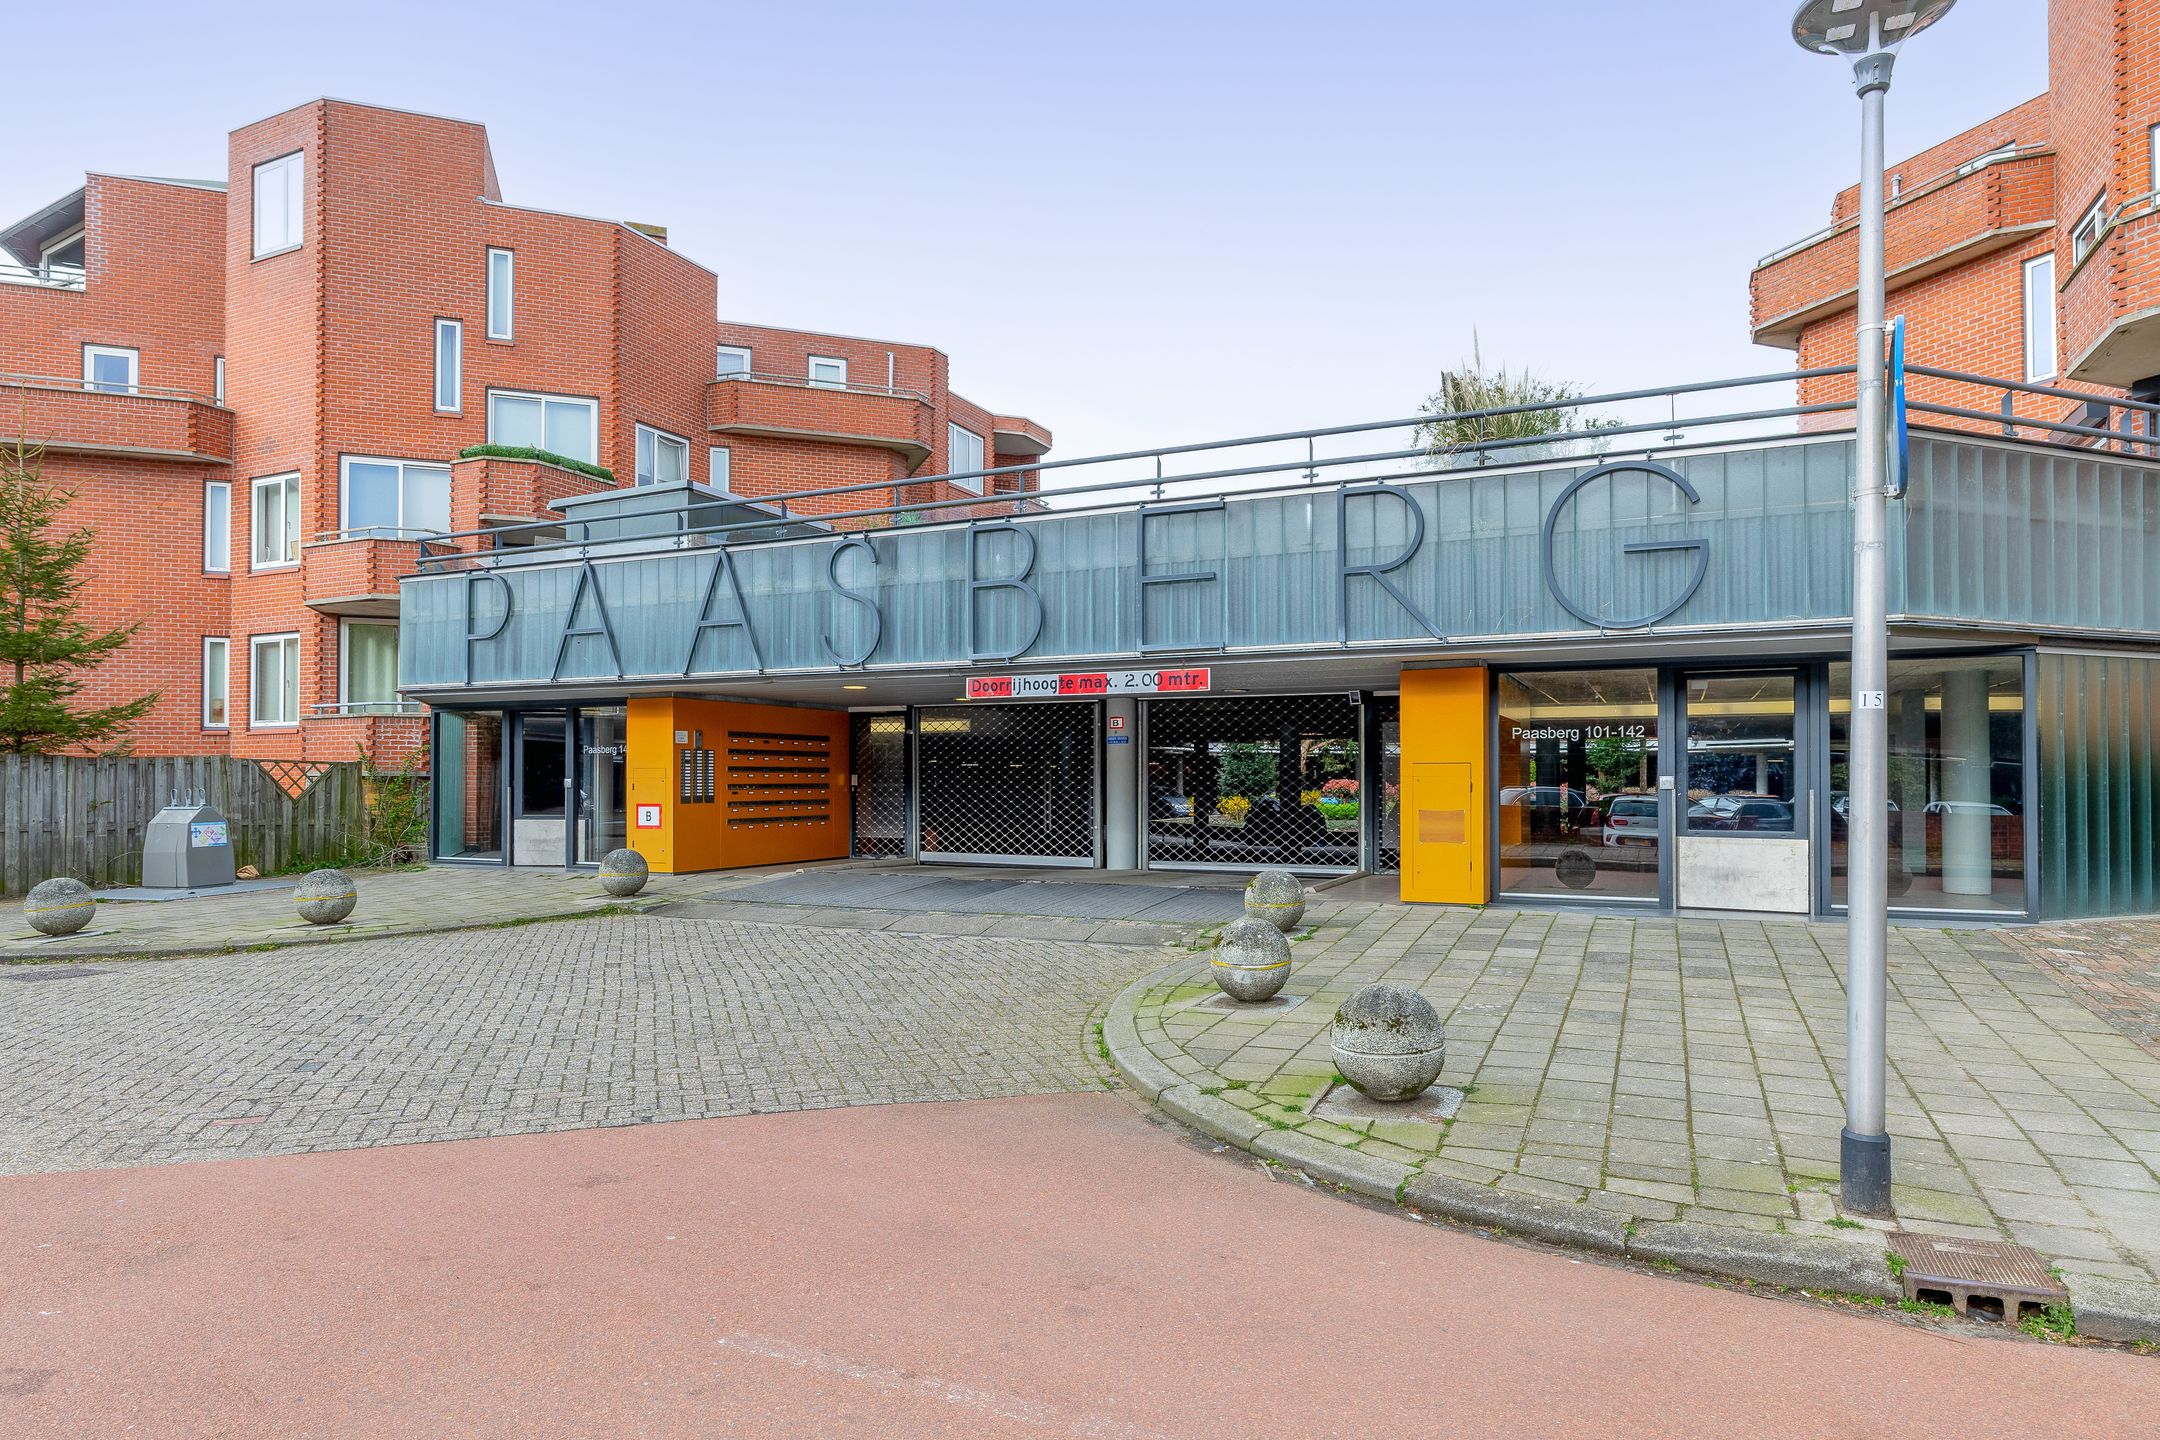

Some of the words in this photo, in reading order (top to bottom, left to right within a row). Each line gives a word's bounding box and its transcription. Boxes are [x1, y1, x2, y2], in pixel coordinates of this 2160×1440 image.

[464, 460, 1709, 687] PAASBERG
[971, 677, 1073, 694] Doorrijhoogte
[1079, 677, 1118, 689] max.
[1124, 673, 1162, 688] 2.00
[1168, 672, 1203, 686] mtr.
[1112, 719, 1119, 727] B
[1512, 726, 1579, 741] Paasberg
[1584, 725, 1645, 739] 101-142
[583, 745, 617, 755] Paasberg
[645, 811, 652, 822] B
